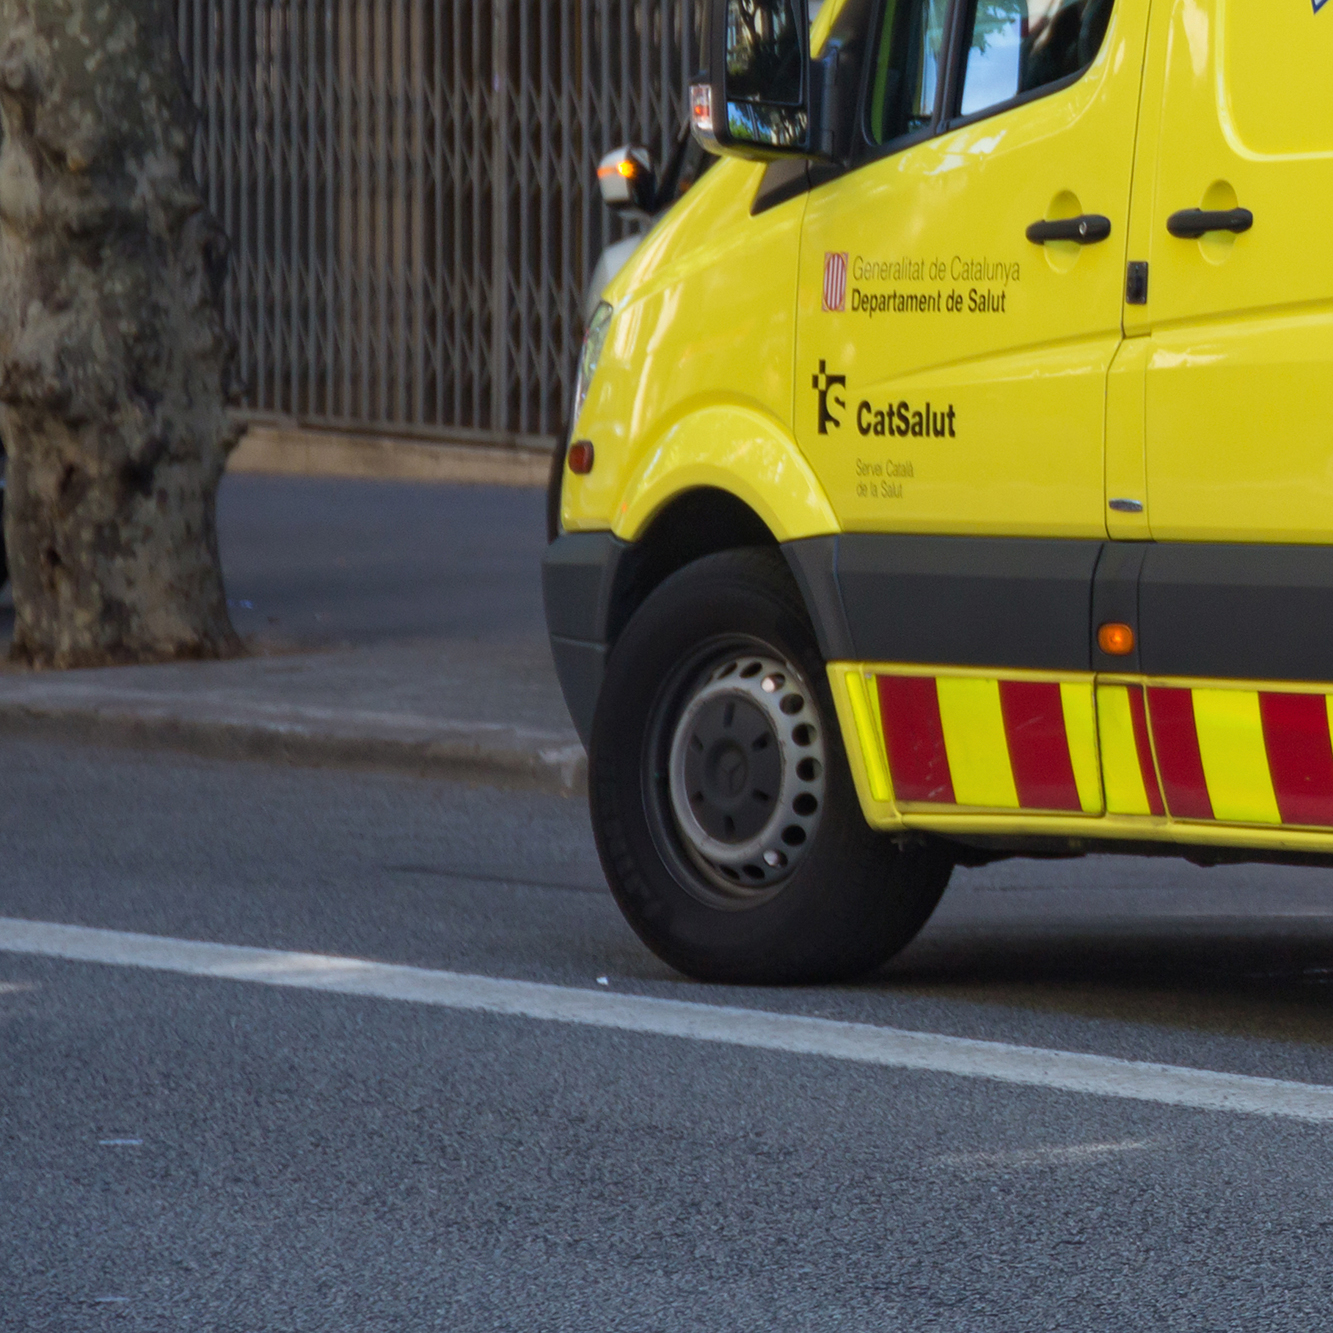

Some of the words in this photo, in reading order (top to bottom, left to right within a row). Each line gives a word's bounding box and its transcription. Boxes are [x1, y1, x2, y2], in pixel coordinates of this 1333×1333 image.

[853, 255, 926, 282] Generalitat
[929, 256, 947, 282] de
[950, 254, 1020, 288] Catalunya
[851, 288, 942, 319] Departament
[946, 288, 963, 313] de
[967, 287, 1007, 314] Salut
[857, 400, 956, 438] CatSalut
